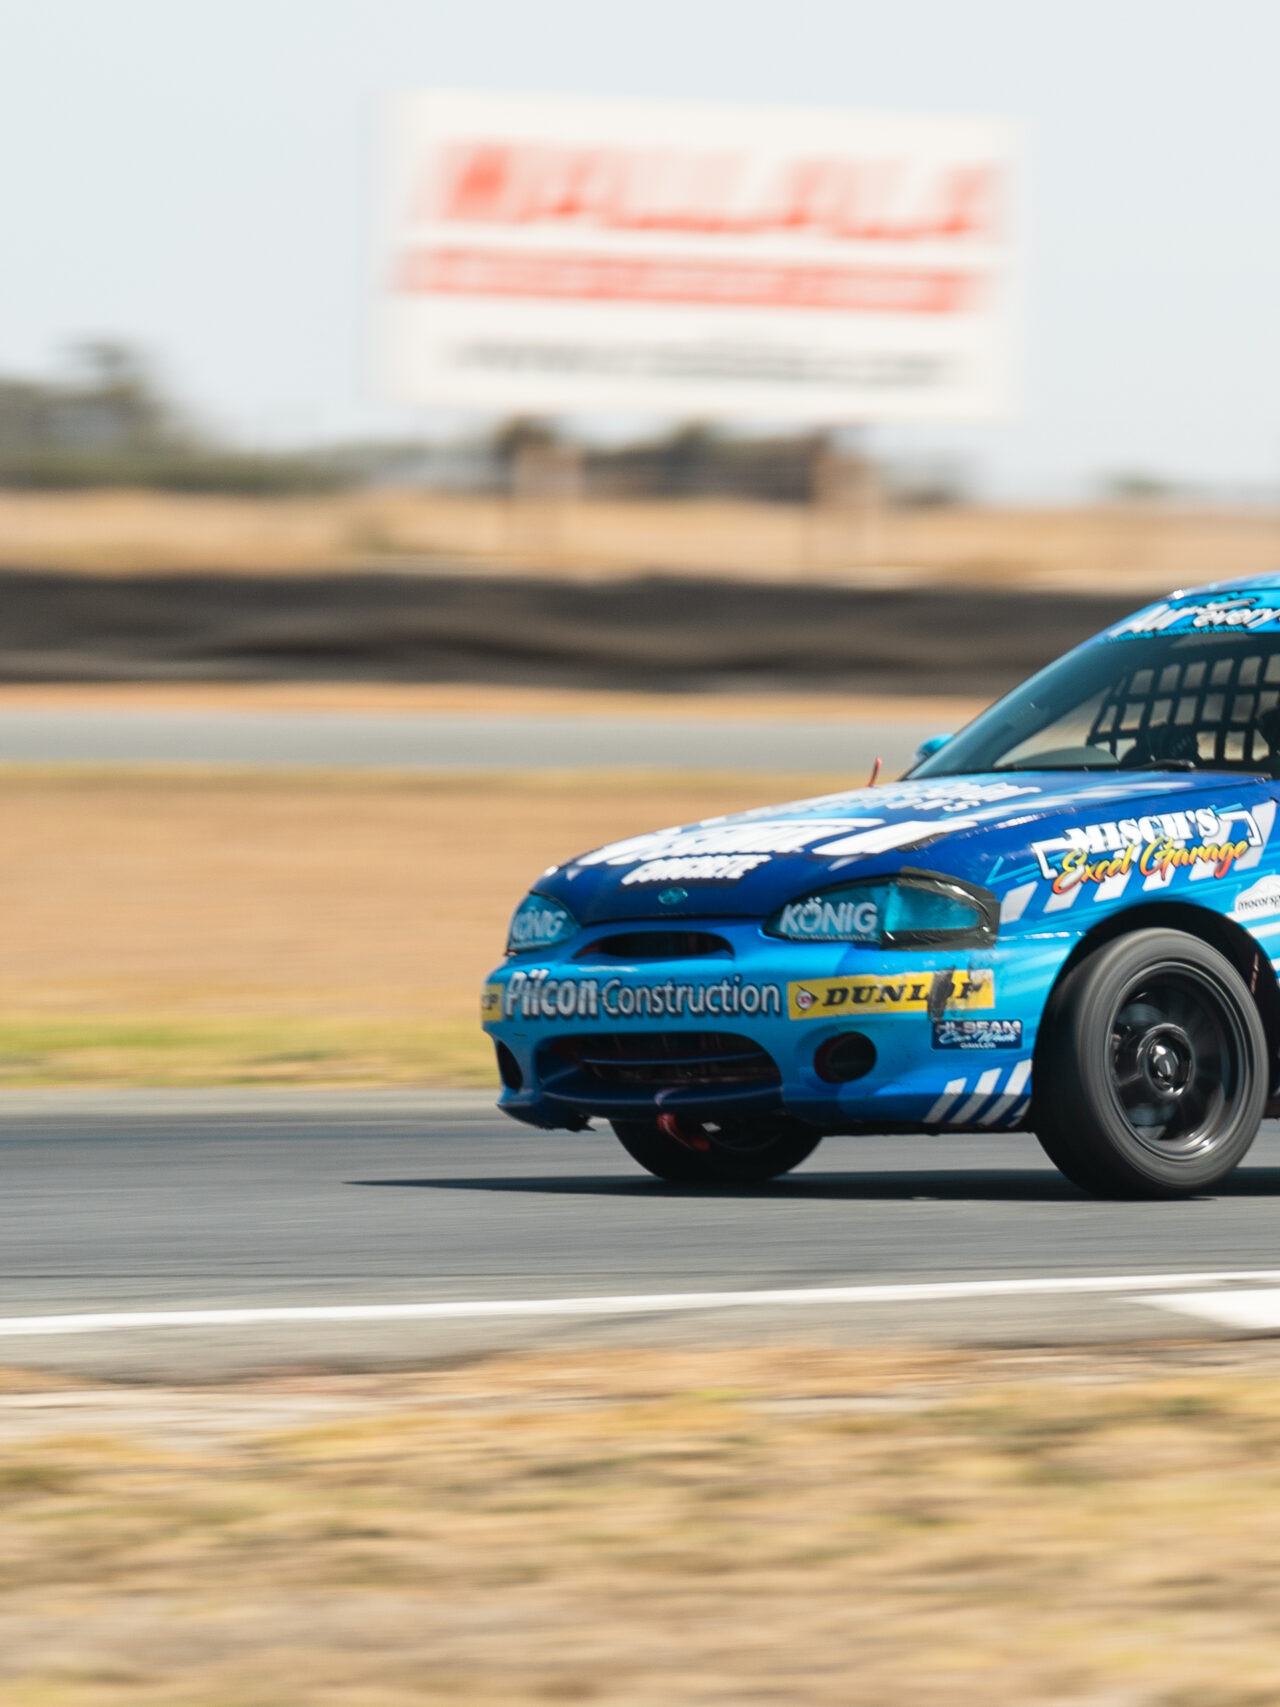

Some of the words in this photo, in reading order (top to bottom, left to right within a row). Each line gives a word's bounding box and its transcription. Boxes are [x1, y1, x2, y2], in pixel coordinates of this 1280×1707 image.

[1064, 807, 1220, 853] MISCH'S
[1052, 844, 1135, 894] Excel
[1140, 837, 1249, 880] Garage
[781, 896, 878, 934] KÖNIG
[602, 975, 780, 1015] Construction
[823, 981, 984, 1006] DUNLP
